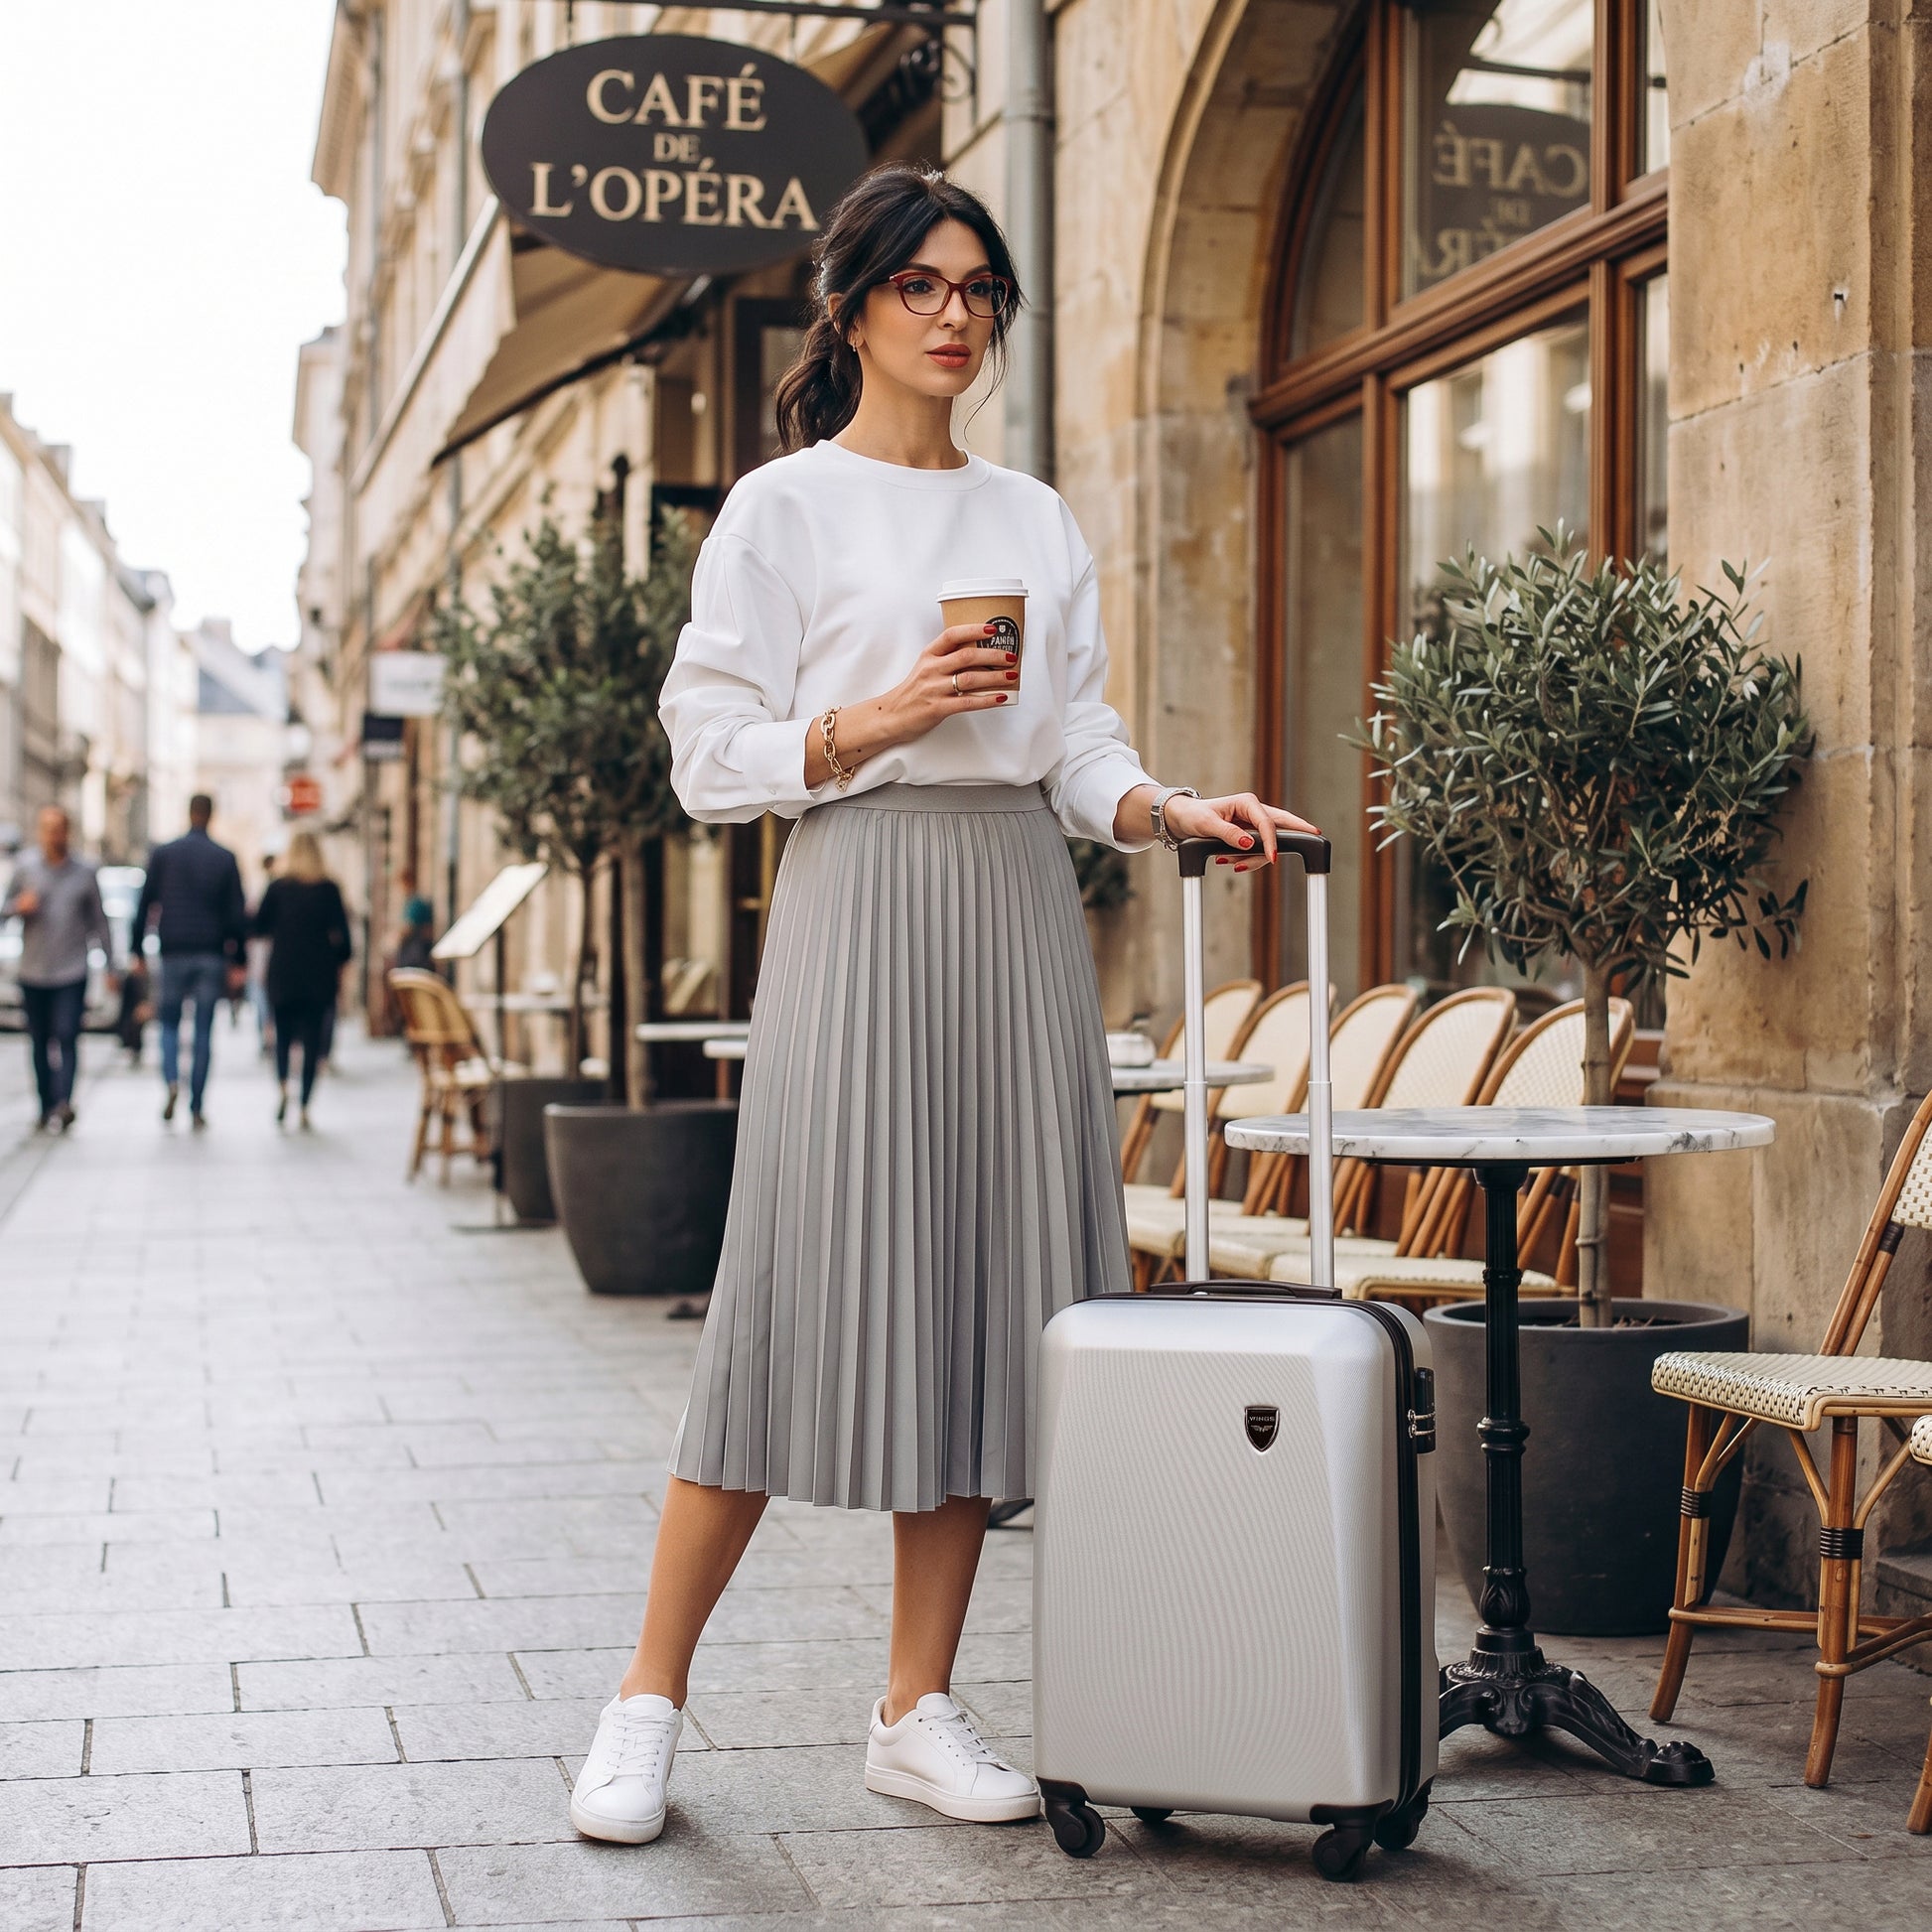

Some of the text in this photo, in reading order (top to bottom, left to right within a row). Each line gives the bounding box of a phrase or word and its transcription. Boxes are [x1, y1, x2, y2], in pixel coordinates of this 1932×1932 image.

[586, 63, 767, 131] CAFÉ
[653, 132, 702, 163] DE
[529, 156, 821, 231] L'OPÉRA
